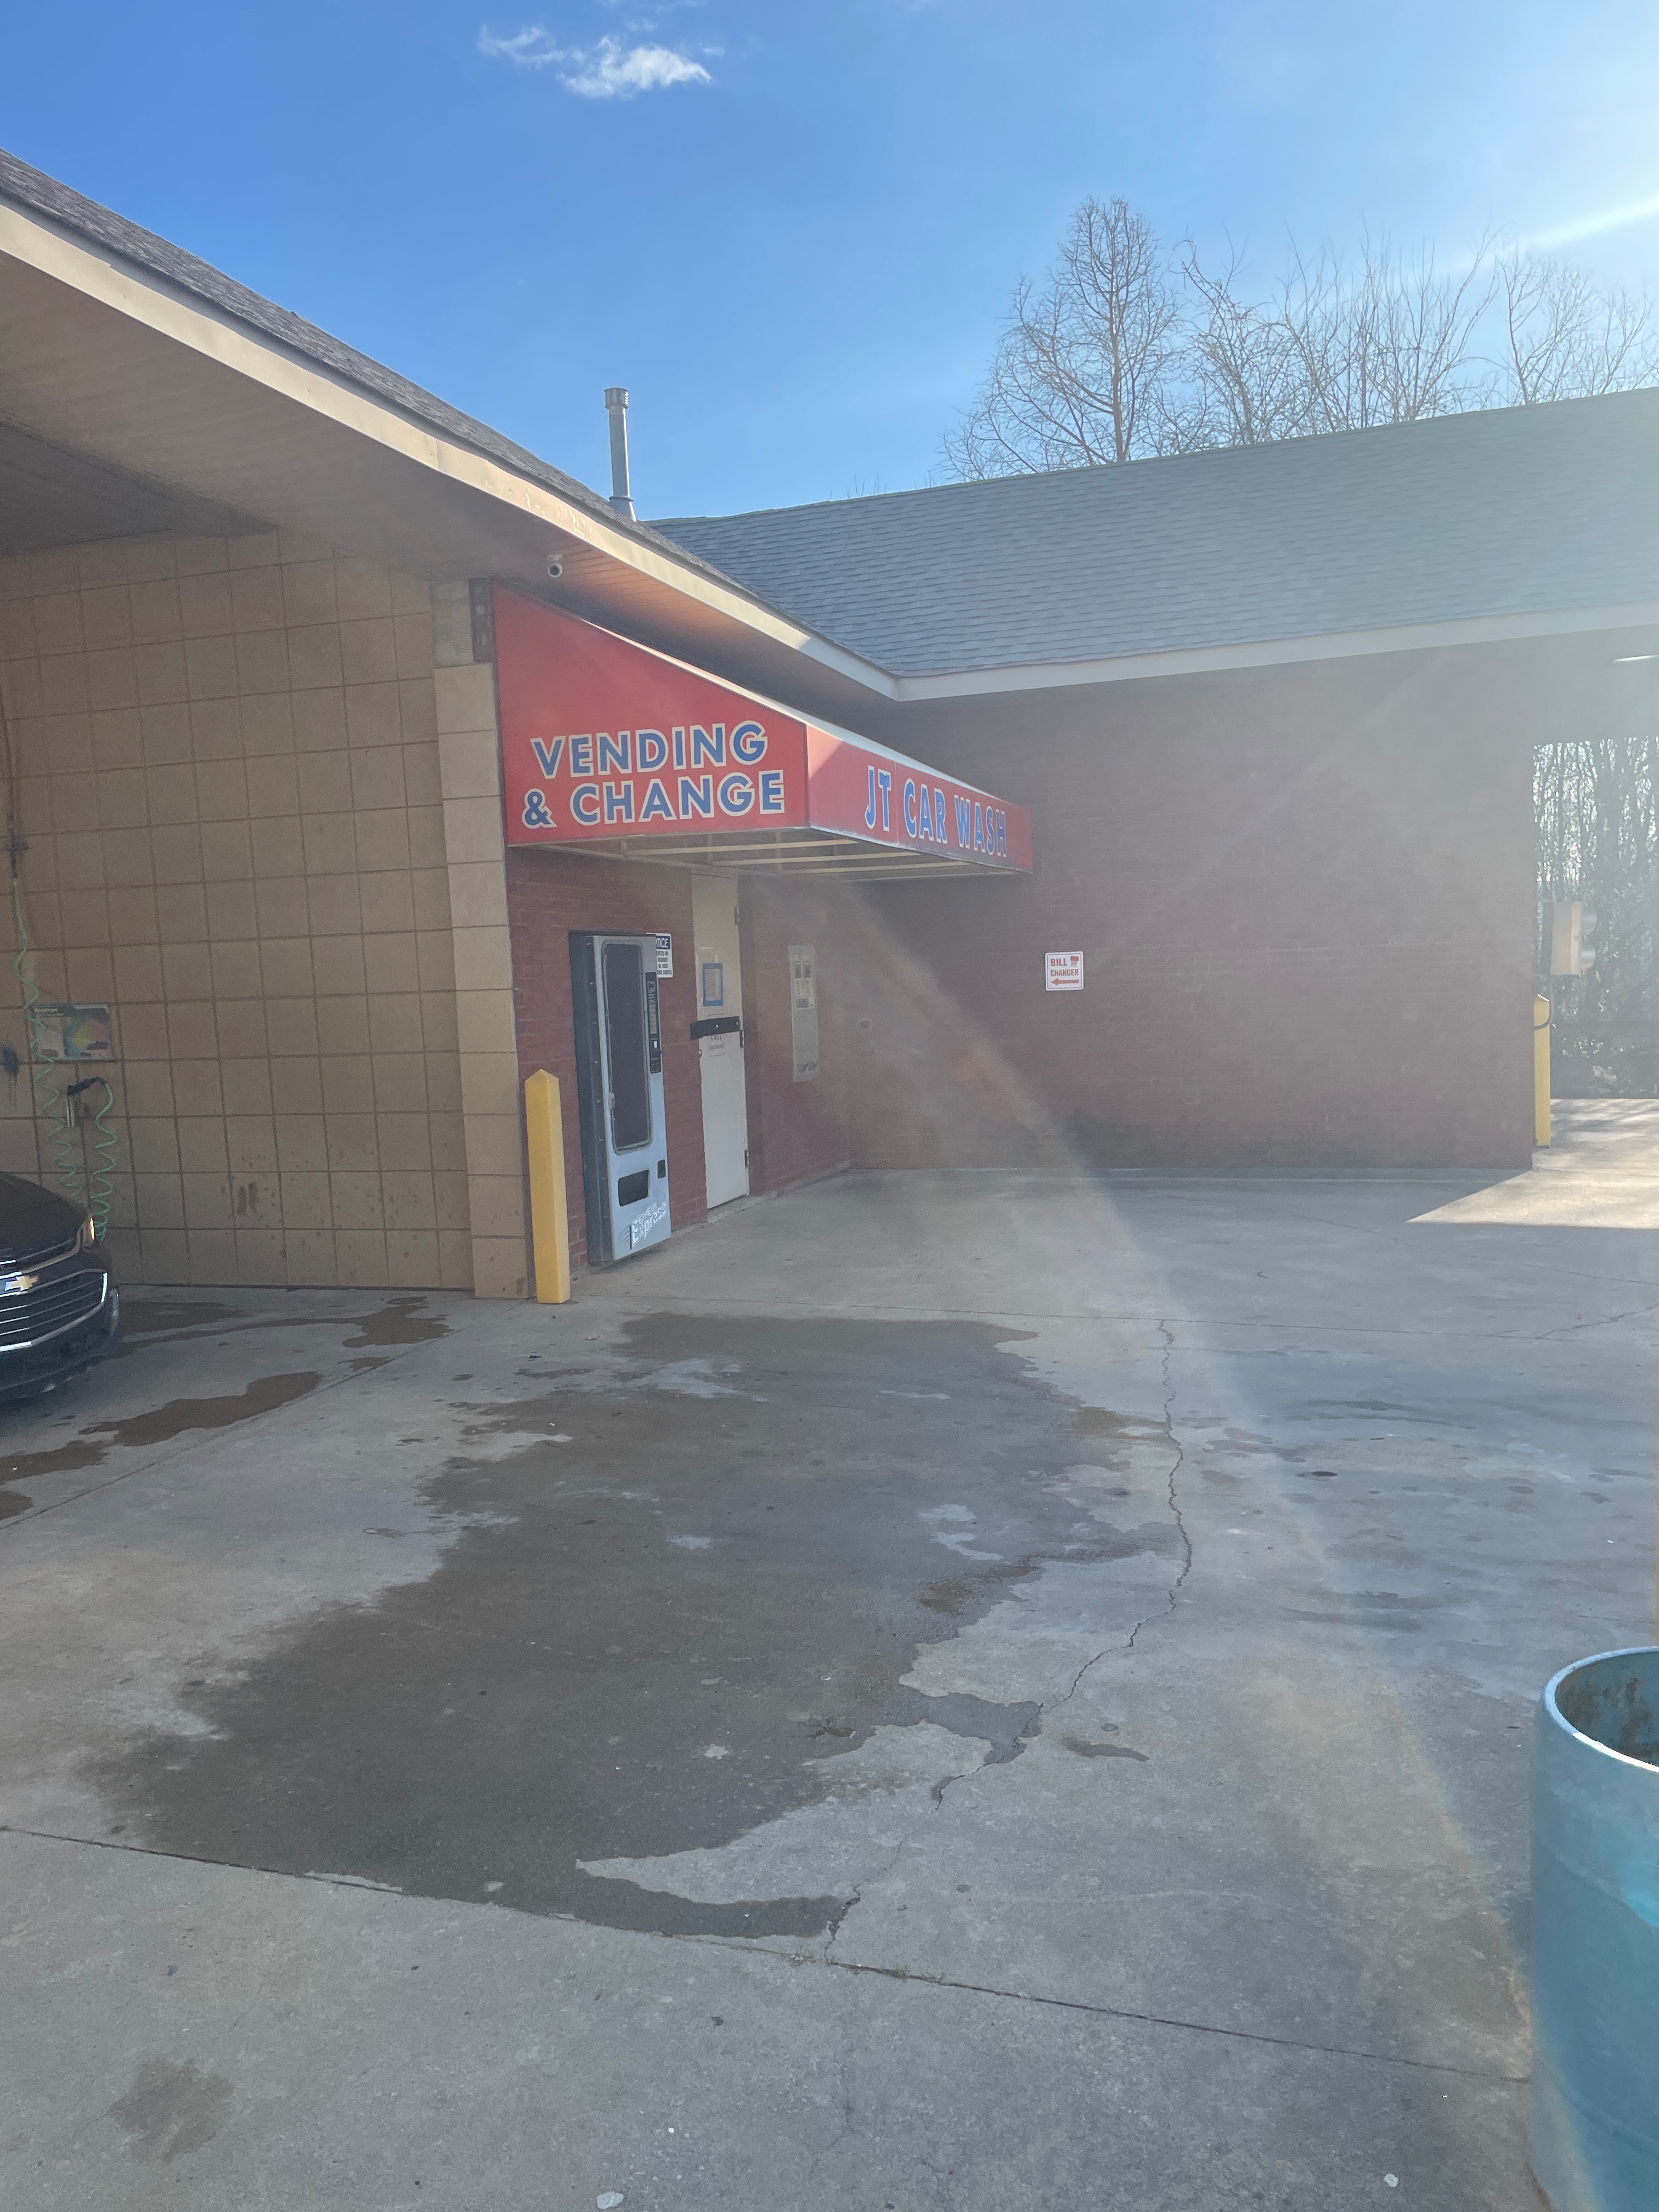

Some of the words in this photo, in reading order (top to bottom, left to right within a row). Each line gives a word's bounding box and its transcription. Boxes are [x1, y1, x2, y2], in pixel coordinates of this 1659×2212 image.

[530, 720, 768, 779] VENDING
[522, 788, 557, 829] &
[570, 770, 785, 826] CHANGE
[865, 765, 891, 832] JT
[904, 778, 948, 844] CAR
[954, 794, 1007, 857] WASH
[1051, 958, 1068, 966] BILL
